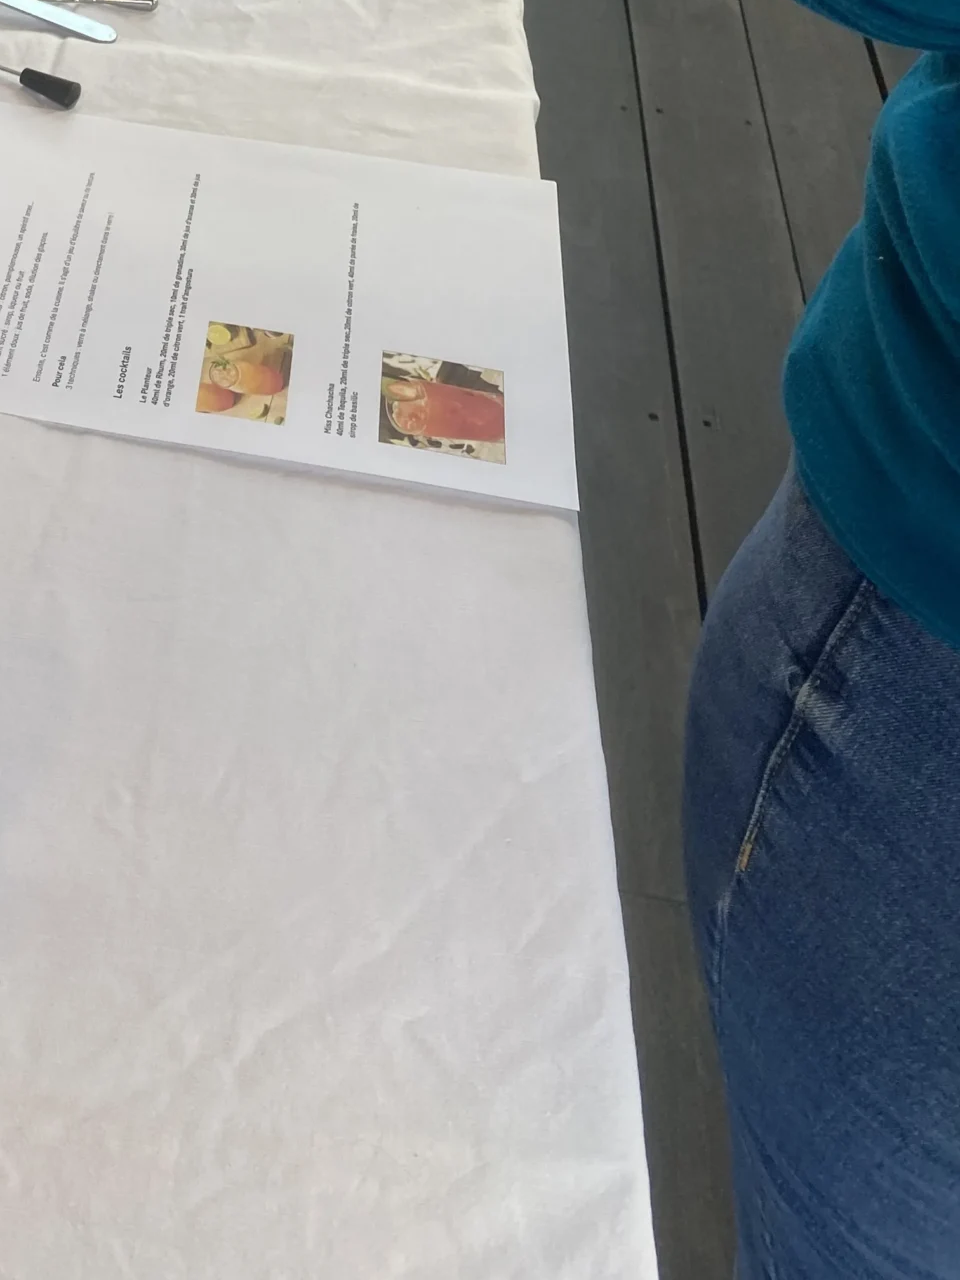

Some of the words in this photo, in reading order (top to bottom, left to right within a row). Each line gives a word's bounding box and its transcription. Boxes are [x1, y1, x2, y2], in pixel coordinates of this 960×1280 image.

[51, 371, 63, 388] Pour
[57, 356, 67, 371] cela
[118, 346, 132, 383] cocktails
[113, 384, 124, 399] Les
[140, 367, 152, 395] Planteur
[139, 395, 147, 404] Le
[325, 383, 335, 419] Chachacha
[323, 420, 332, 434] Miss
